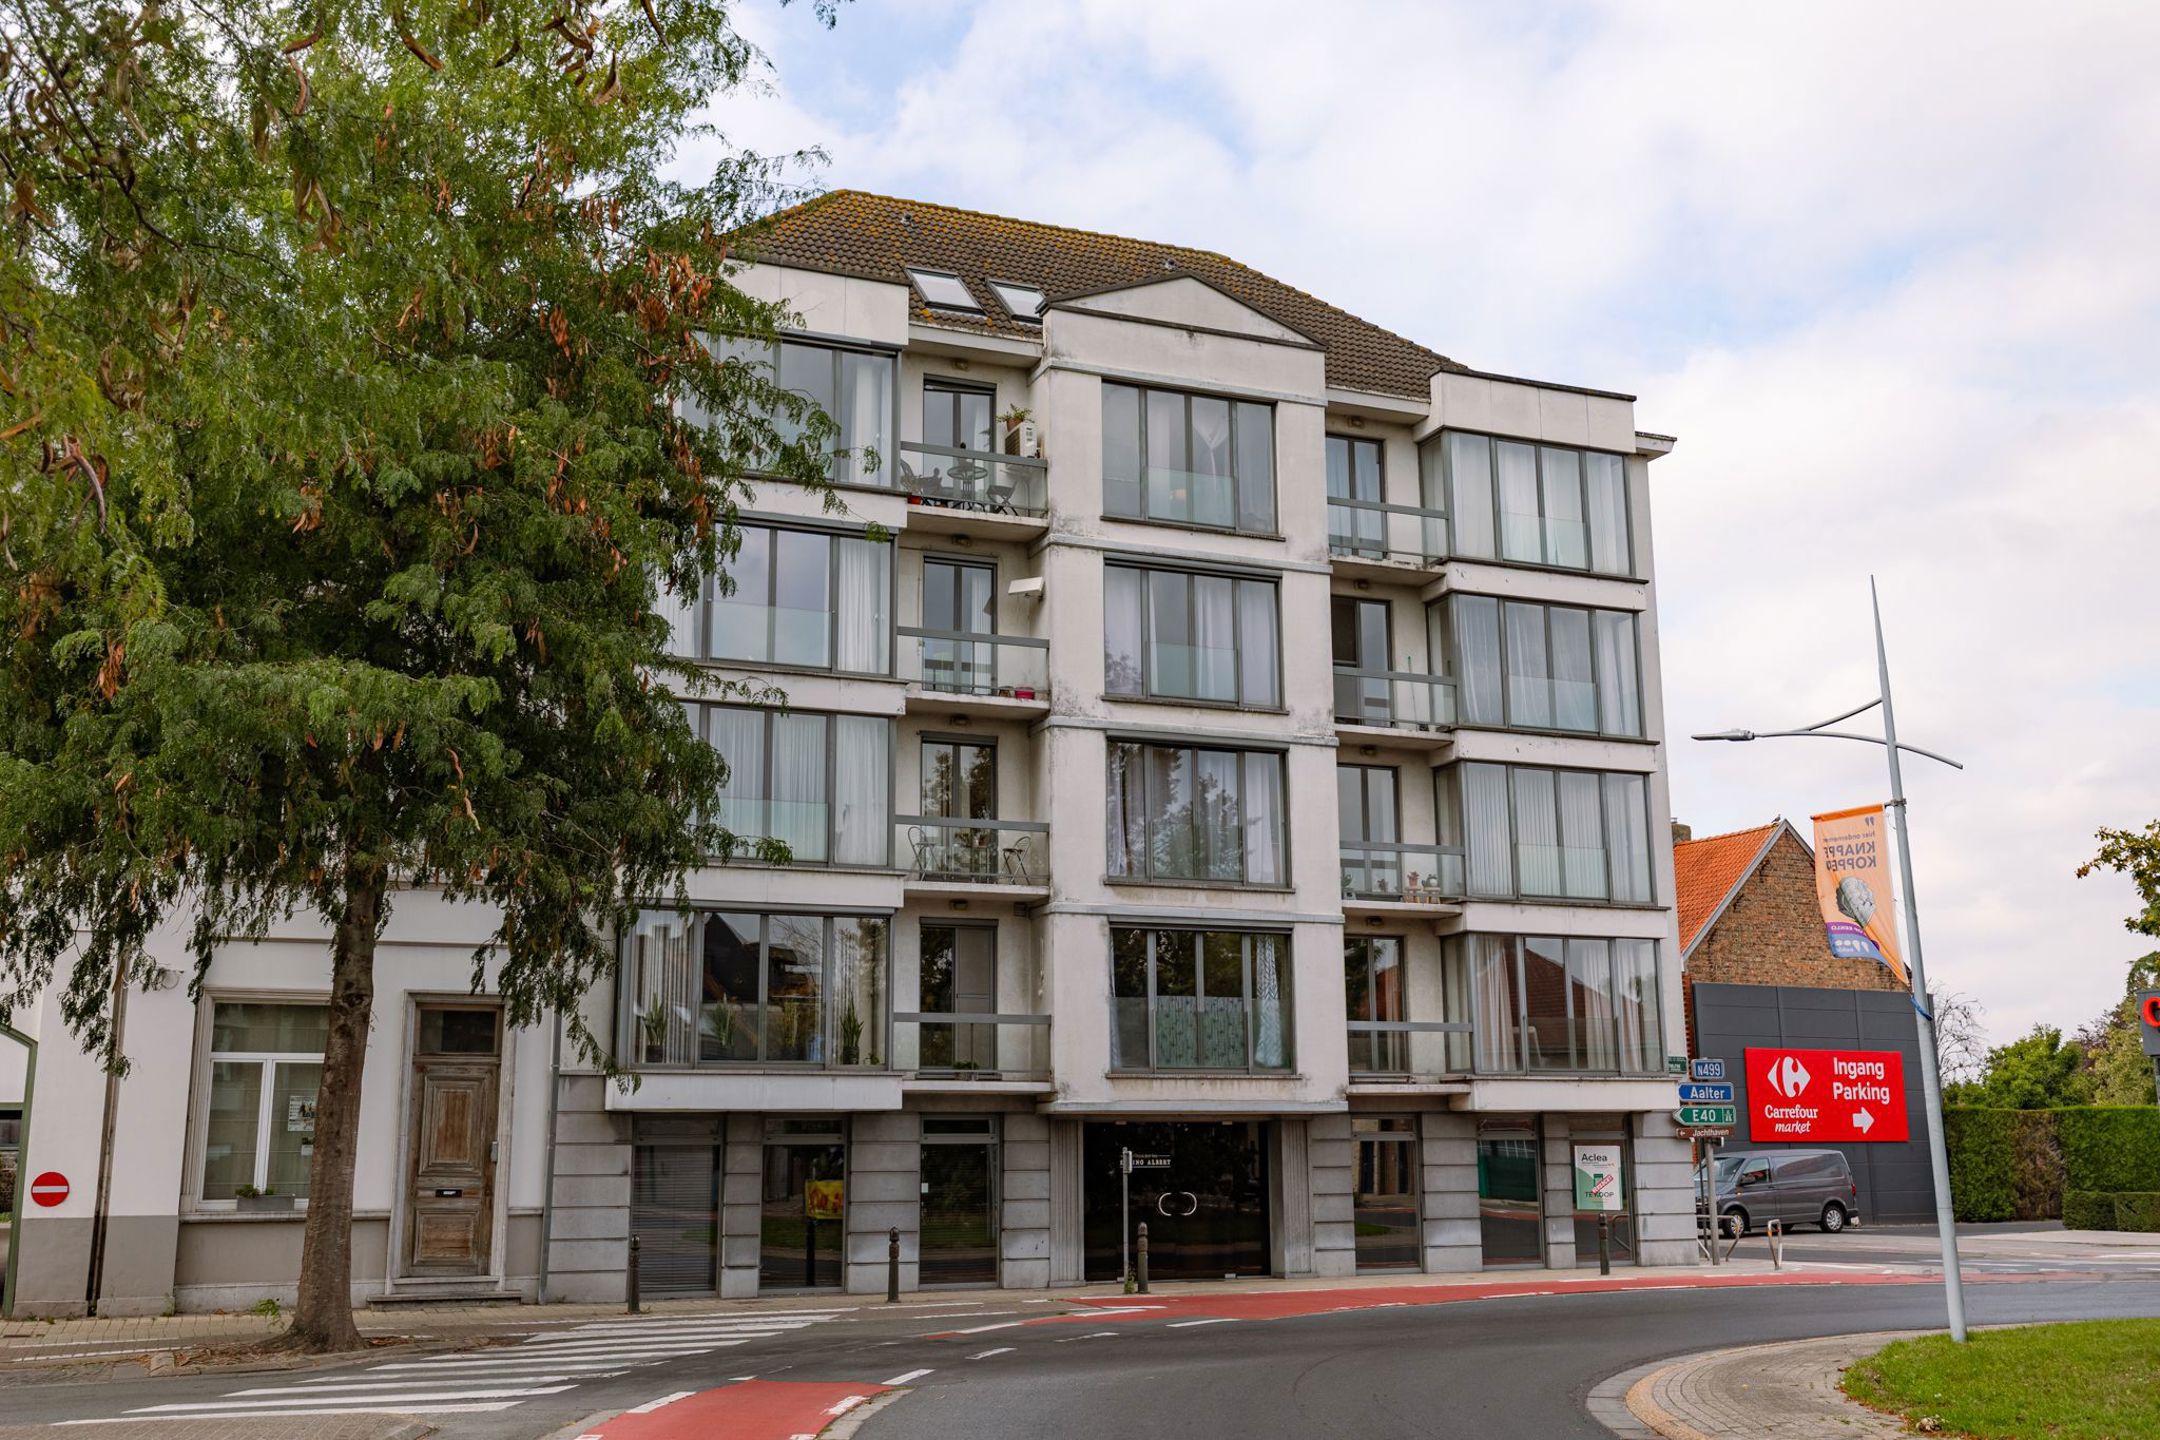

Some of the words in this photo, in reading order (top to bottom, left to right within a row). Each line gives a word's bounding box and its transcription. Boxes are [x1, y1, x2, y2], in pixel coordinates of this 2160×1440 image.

[1697, 1063, 1721, 1076] N499
[1833, 1057, 1885, 1080] Ingang
[1690, 1086, 1726, 1099] Aalter
[1833, 1081, 1890, 1104] Parking
[1764, 1104, 1818, 1119] Carrefour
[1692, 1129, 1729, 1137] Jachthaven
[1775, 1121, 1811, 1134] market
